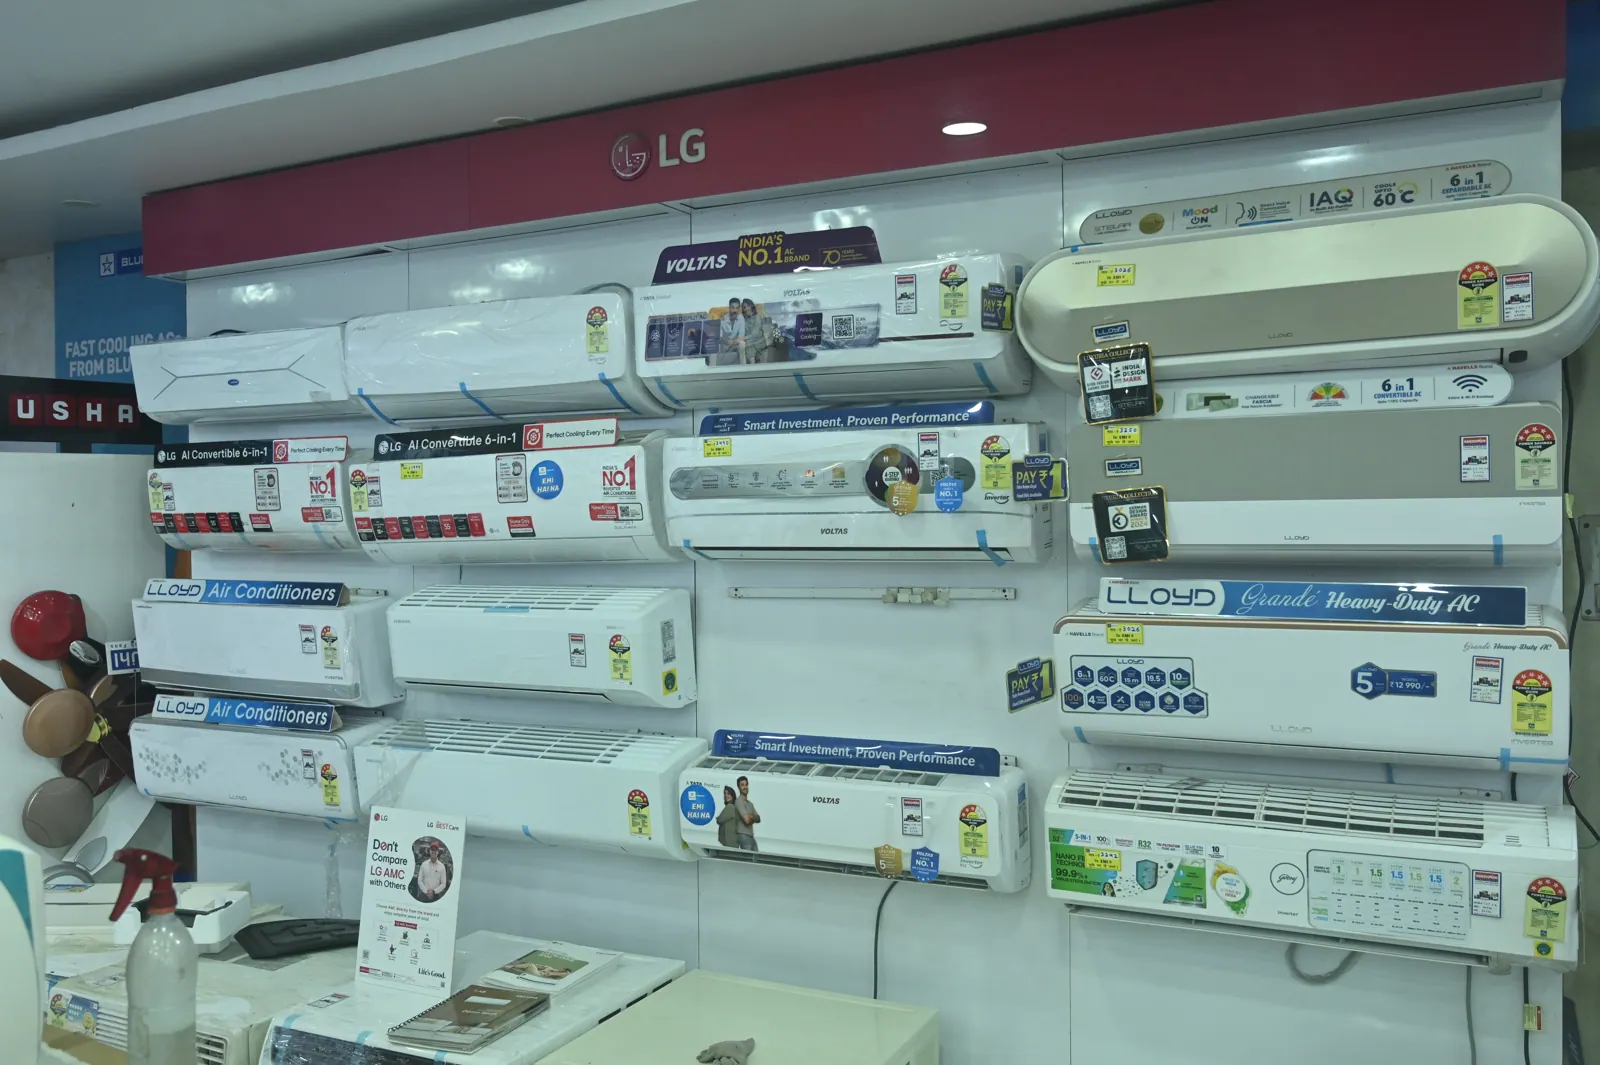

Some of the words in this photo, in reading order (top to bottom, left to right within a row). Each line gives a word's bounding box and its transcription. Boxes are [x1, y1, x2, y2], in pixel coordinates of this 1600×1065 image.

[658, 128, 706, 168] LG
[1450, 174, 1461, 187] 6
[1464, 177, 1473, 185] in
[1475, 171, 1484, 184] 1
[1309, 188, 1354, 208] IAQ
[1095, 209, 1132, 219] LLOYD
[1182, 205, 1218, 217] Mood
[739, 234, 783, 249] INDIA'S
[738, 246, 783, 267] NO.1
[784, 254, 810, 263] BRAND
[823, 249, 841, 265] 70
[666, 254, 728, 274] VOLTAS
[65, 339, 96, 359] FAST
[70, 359, 105, 378] FROM
[107, 356, 133, 374] BLU
[1122, 369, 1146, 377] DESIGN
[1381, 379, 1392, 392] 6
[1406, 377, 1414, 391] 1
[17, 398, 134, 423] USHA
[743, 419, 776, 431] Smart
[778, 416, 844, 429] Investment,
[846, 414, 888, 427] Proven
[891, 411, 970, 425] Performance
[390, 442, 401, 452] LG
[408, 440, 419, 450] AI
[421, 436, 482, 449] Convertible
[485, 432, 516, 445] 6-in-1
[545, 431, 565, 439] Perfect
[167, 452, 177, 461] LG
[181, 451, 190, 460] AI
[192, 447, 240, 459] Convertible
[242, 446, 268, 458] 6-in-1
[1016, 470, 1037, 484] PAY
[892, 496, 899, 506] 5
[147, 583, 202, 596] LLOYD
[207, 583, 232, 598] Air
[235, 583, 337, 601] Conditioners
[1107, 586, 1216, 607] LLOYD
[1324, 590, 1443, 615] Heavy-Duty
[1446, 594, 1480, 613] AC
[1493, 643, 1538, 652] Heavy-Duty
[1171, 672, 1182, 680] 10
[1355, 671, 1373, 694] 5
[1011, 675, 1030, 693] PAY
[1088, 695, 1096, 705] 4
[156, 701, 205, 715] LLOYD
[210, 704, 232, 718] Air
[234, 704, 328, 726] Conditioners
[755, 739, 787, 752] Smart
[789, 740, 853, 759] Investment,
[855, 747, 896, 761] Proven
[899, 750, 976, 767] Performance
[812, 796, 840, 805] VOLTAS
[1075, 833, 1091, 841] 5-IN-1
[1138, 840, 1151, 848] R32
[372, 838, 399, 853] Don't
[1211, 845, 1220, 853] 10
[371, 852, 408, 866] Compare
[1055, 852, 1076, 861] NANO
[879, 859, 886, 869] 5
[370, 865, 382, 877] LG
[383, 867, 405, 880] AMC
[1370, 868, 1383, 877] 1.5
[1390, 870, 1404, 880] 1.5
[1429, 874, 1442, 883] 1.5
[369, 878, 383, 887] with
[383, 880, 407, 891] Others
[418, 967, 431, 976] Life's
[430, 970, 446, 979] Good.
